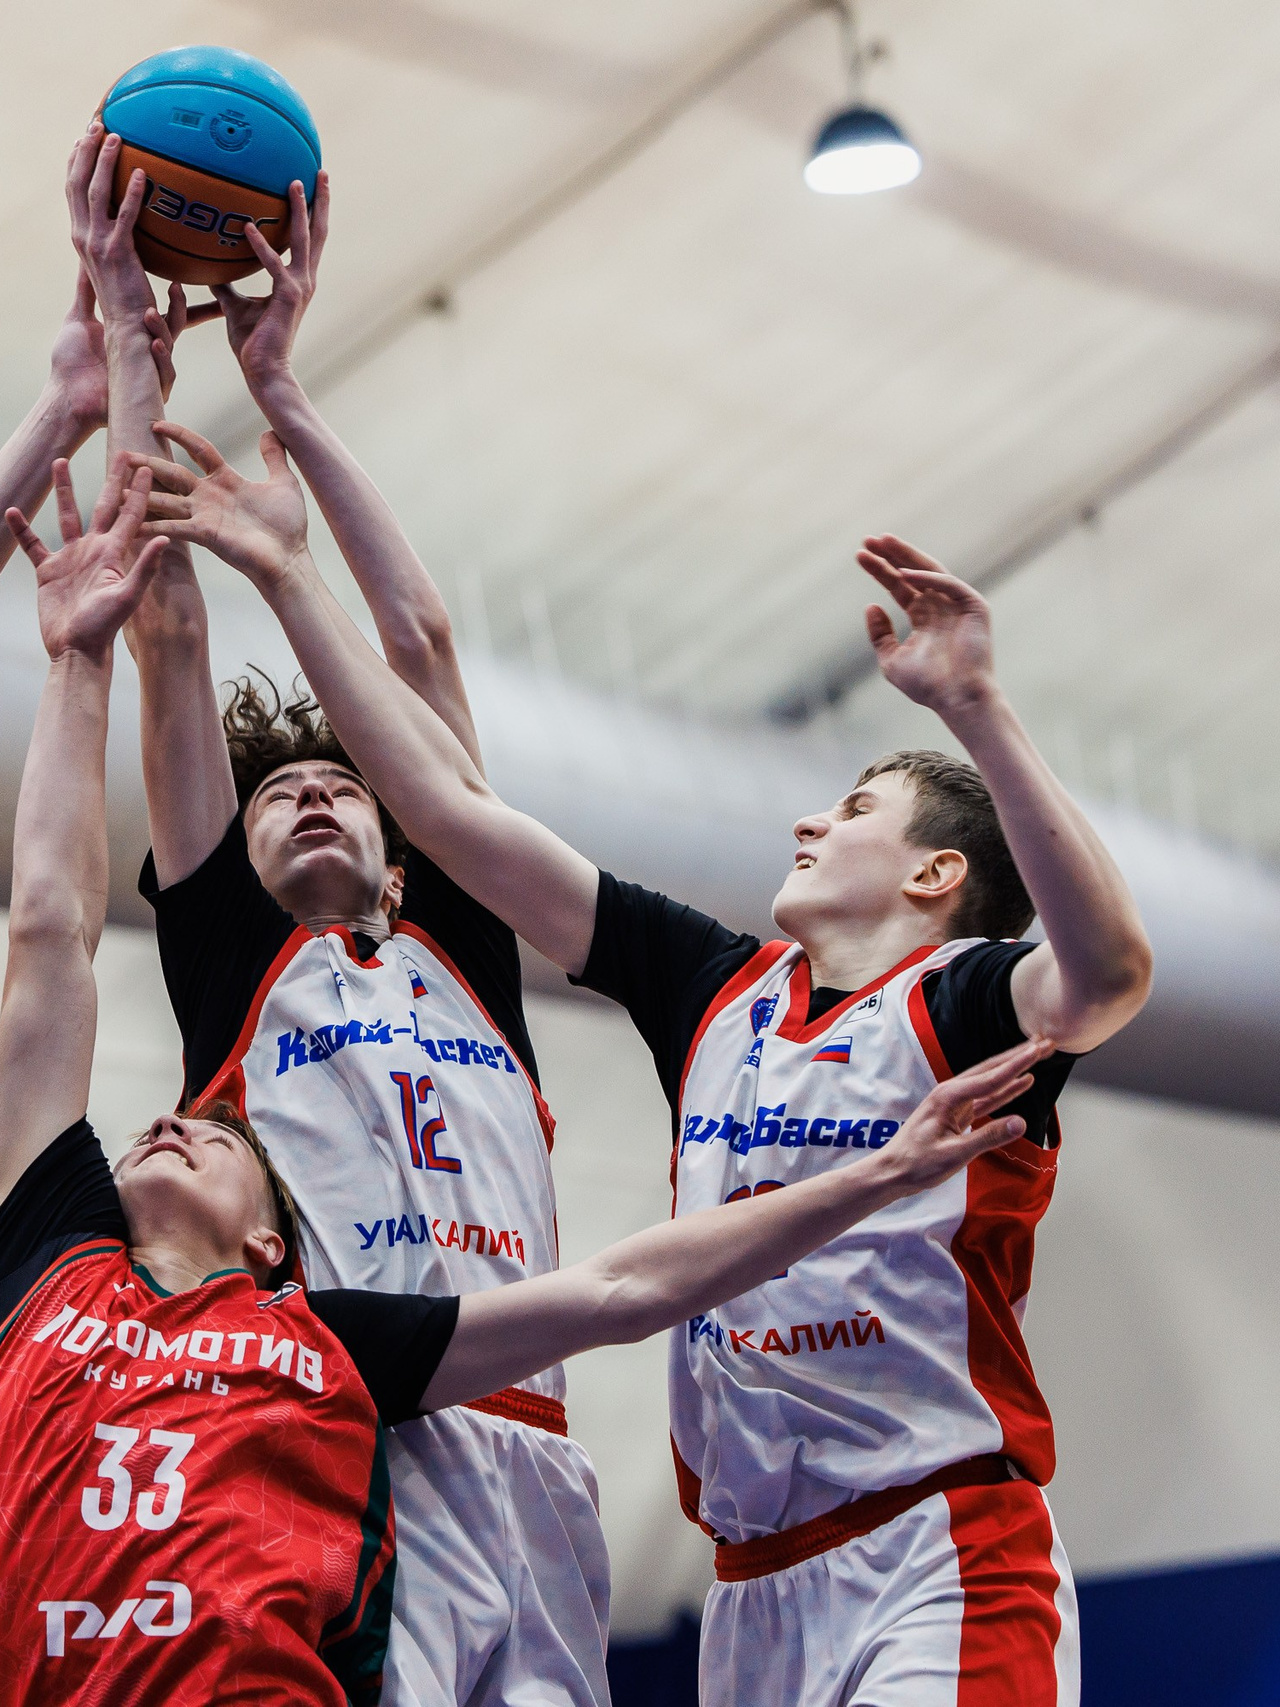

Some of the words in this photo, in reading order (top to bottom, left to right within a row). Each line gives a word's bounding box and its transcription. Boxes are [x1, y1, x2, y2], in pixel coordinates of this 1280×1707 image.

[389, 1071, 463, 1175] 12
[33, 1303, 324, 1394] ЛООМОТИВ
[80, 1422, 196, 1531] 33
